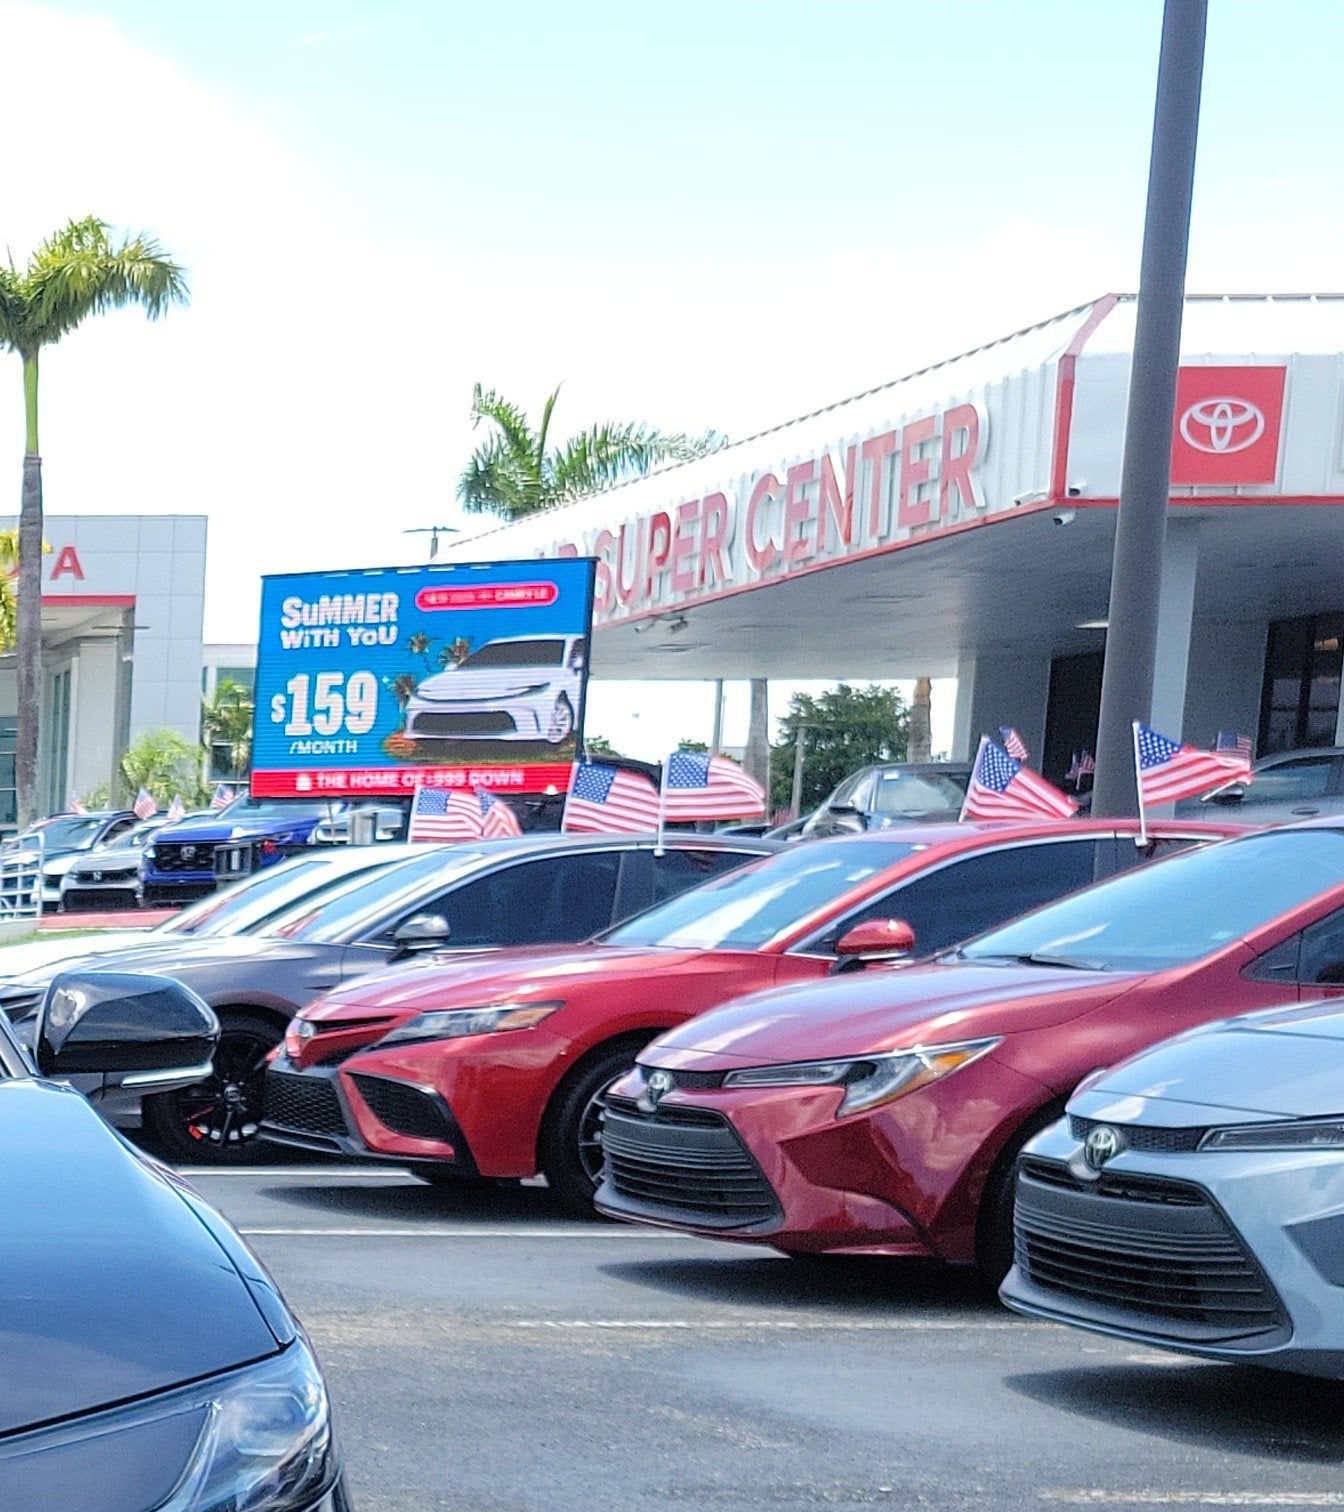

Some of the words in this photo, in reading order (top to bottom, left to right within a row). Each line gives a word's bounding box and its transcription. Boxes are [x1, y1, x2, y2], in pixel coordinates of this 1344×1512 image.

[593, 490, 730, 614] SUPER
[745, 403, 982, 573] CENTER
[271, 670, 378, 736] $159
[316, 772, 347, 789] THE
[349, 771, 399, 788] HOME
